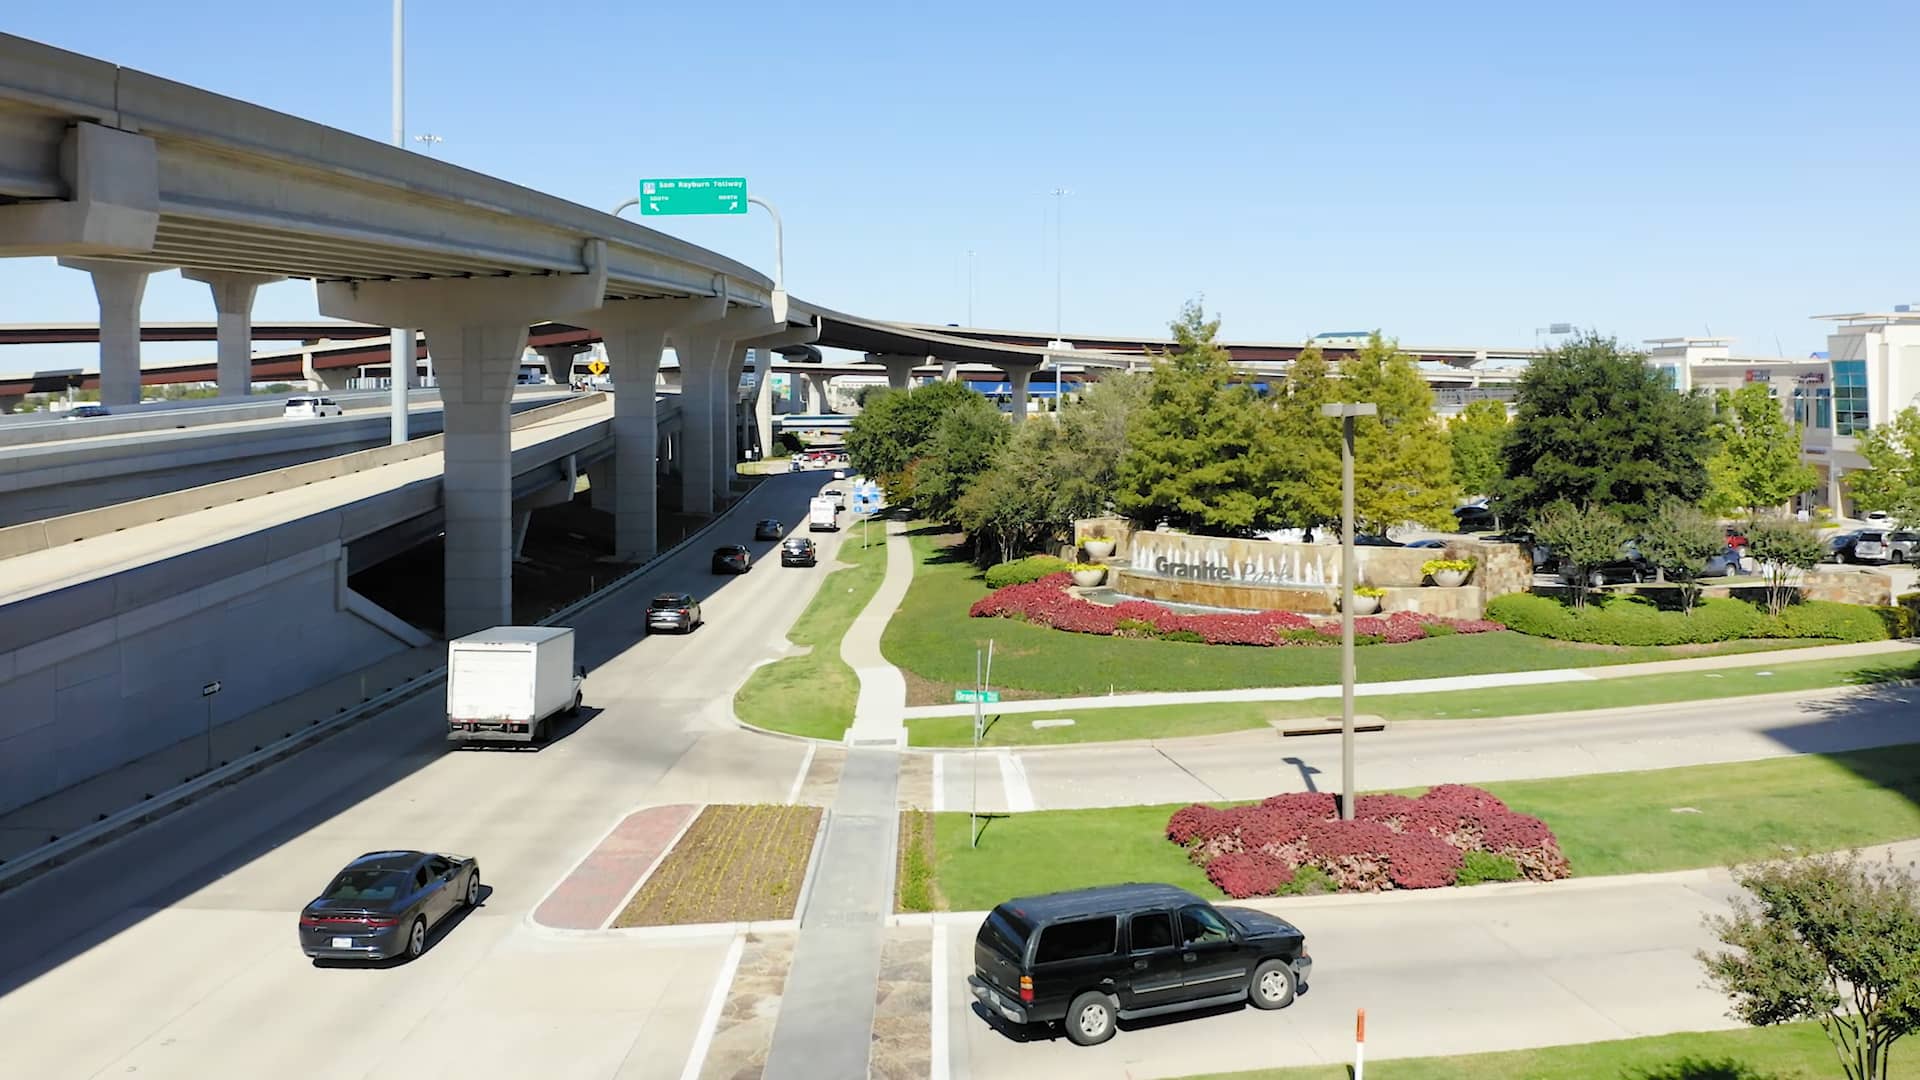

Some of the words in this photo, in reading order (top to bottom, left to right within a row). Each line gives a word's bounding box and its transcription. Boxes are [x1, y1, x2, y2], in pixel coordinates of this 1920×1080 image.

[678, 181, 710, 189] Rayburn
[1155, 556, 1231, 581] Granite
[1242, 562, 1294, 585] Park
